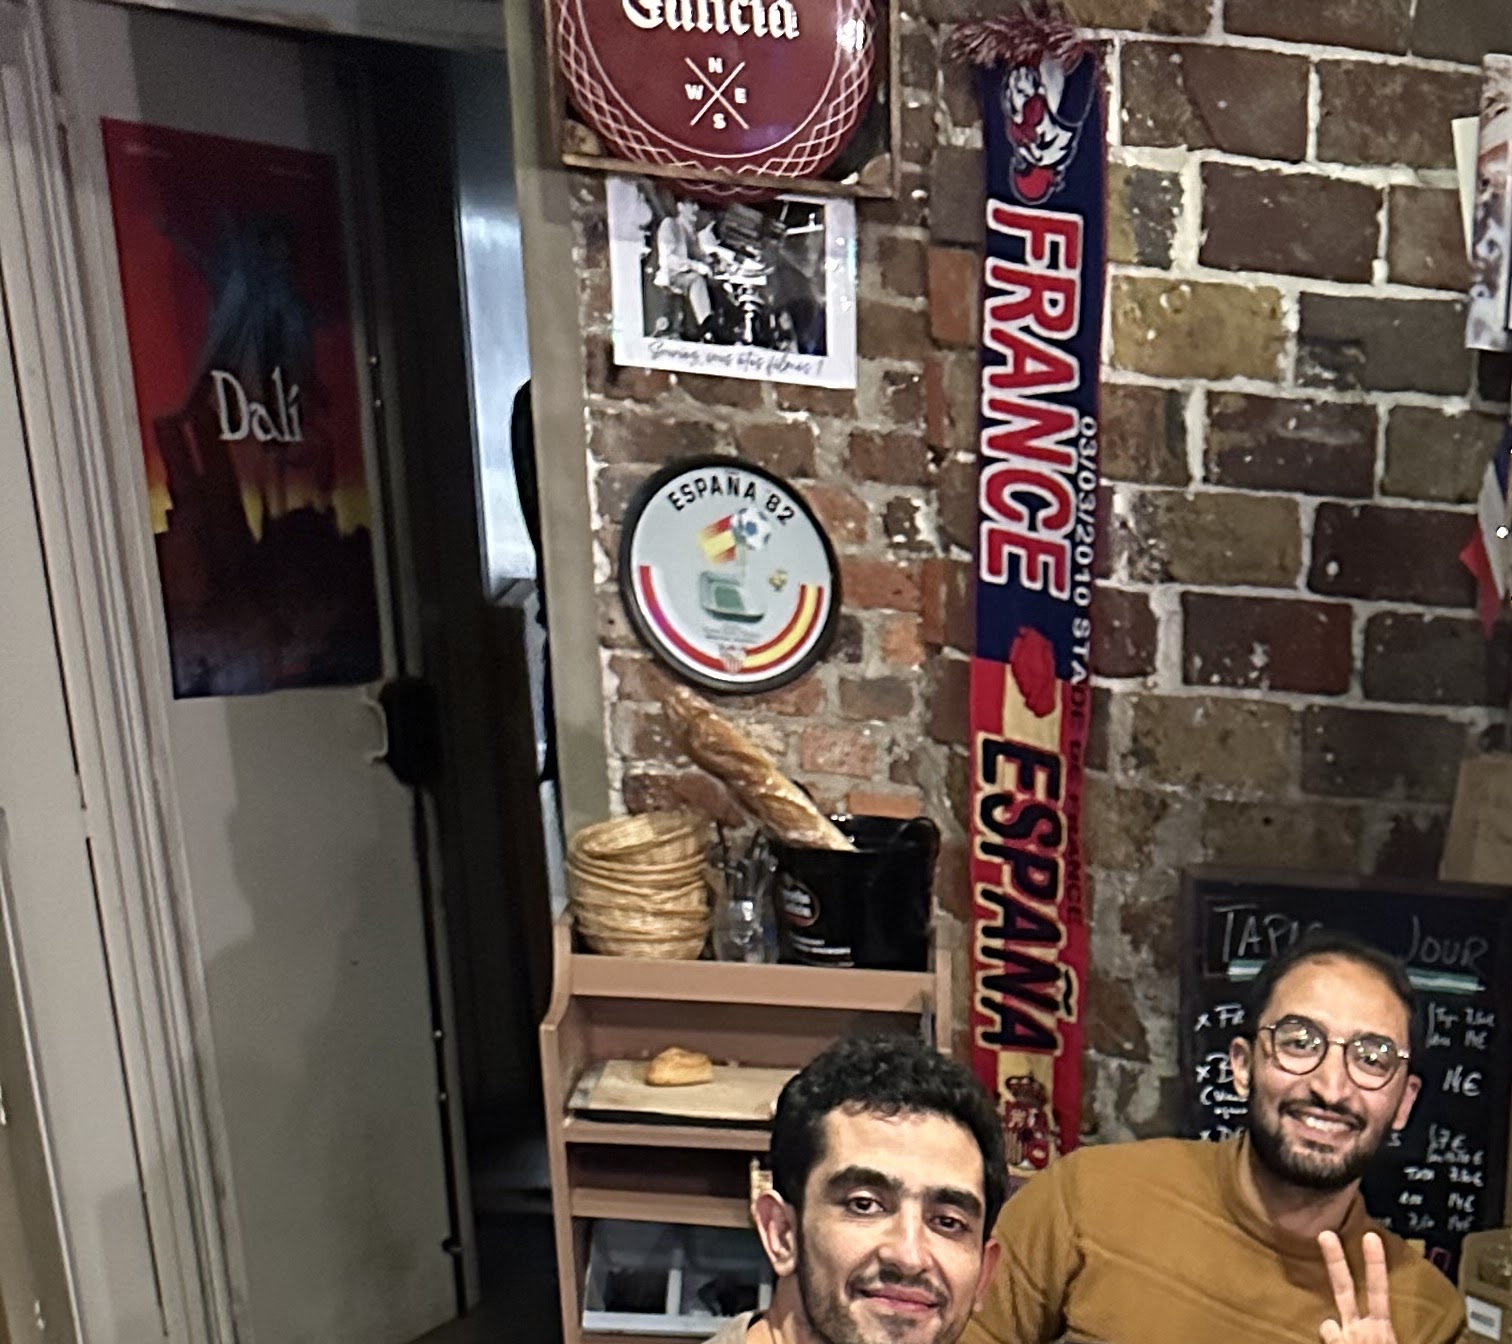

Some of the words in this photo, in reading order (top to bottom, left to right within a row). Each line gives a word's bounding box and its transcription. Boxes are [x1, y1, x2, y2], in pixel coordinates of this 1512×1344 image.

[684, 83, 704, 102] W
[734, 87, 748, 105] E
[707, 56, 724, 75] N
[712, 112, 727, 130] S
[210, 365, 303, 442] Dalí
[980, 198, 1084, 600] FRANCE
[766, 493, 796, 525] 82
[1071, 415, 1098, 608] 03/03/2010
[1069, 616, 1091, 717] STADE
[974, 734, 1078, 1056] ESPAÑA
